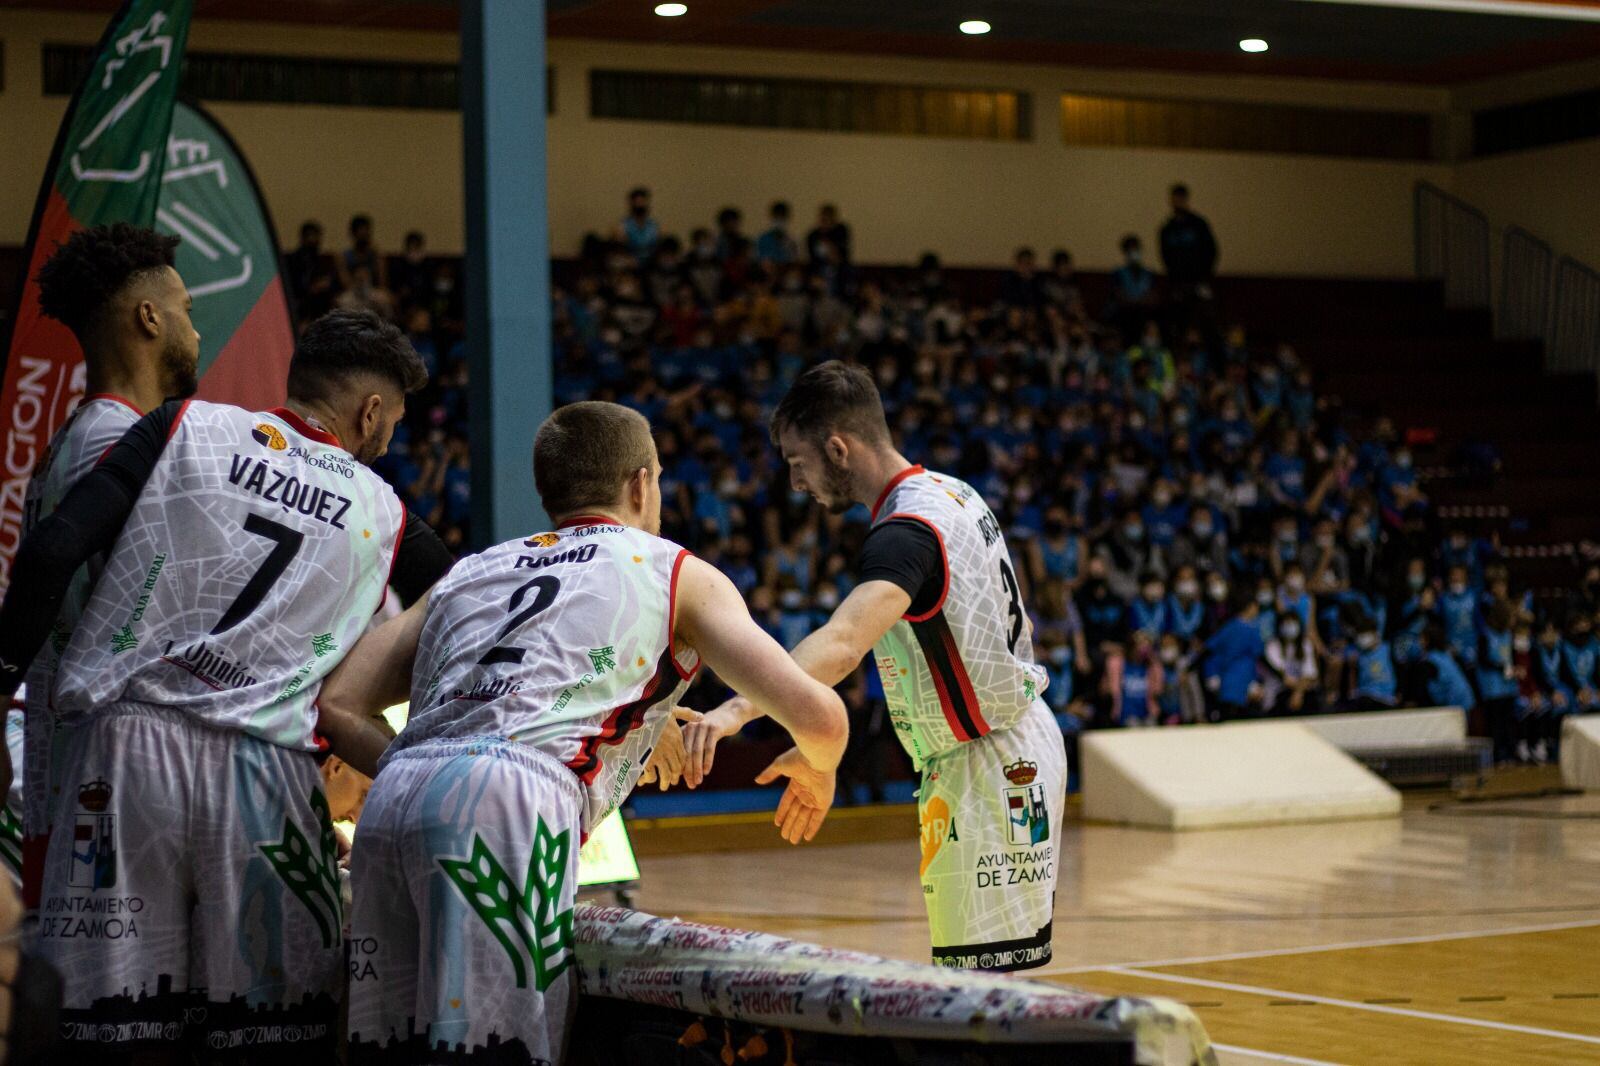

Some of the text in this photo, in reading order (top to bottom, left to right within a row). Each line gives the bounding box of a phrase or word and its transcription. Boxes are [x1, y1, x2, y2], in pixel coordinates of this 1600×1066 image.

[287, 447, 354, 479] ZAMORANO
[228, 455, 352, 530] VÁZQUEZ
[132, 553, 167, 621] CAJA RURAL
[209, 512, 305, 636] 7
[477, 575, 561, 665] 2
[1000, 558, 1023, 655] 3
[977, 870, 1002, 888] DE
[60, 918, 139, 939] ZAMOA
[957, 954, 978, 969] ZMR
[994, 951, 1013, 966] ZMR
[136, 1022, 163, 1040] ZMR
[256, 1026, 282, 1043] ZMR
